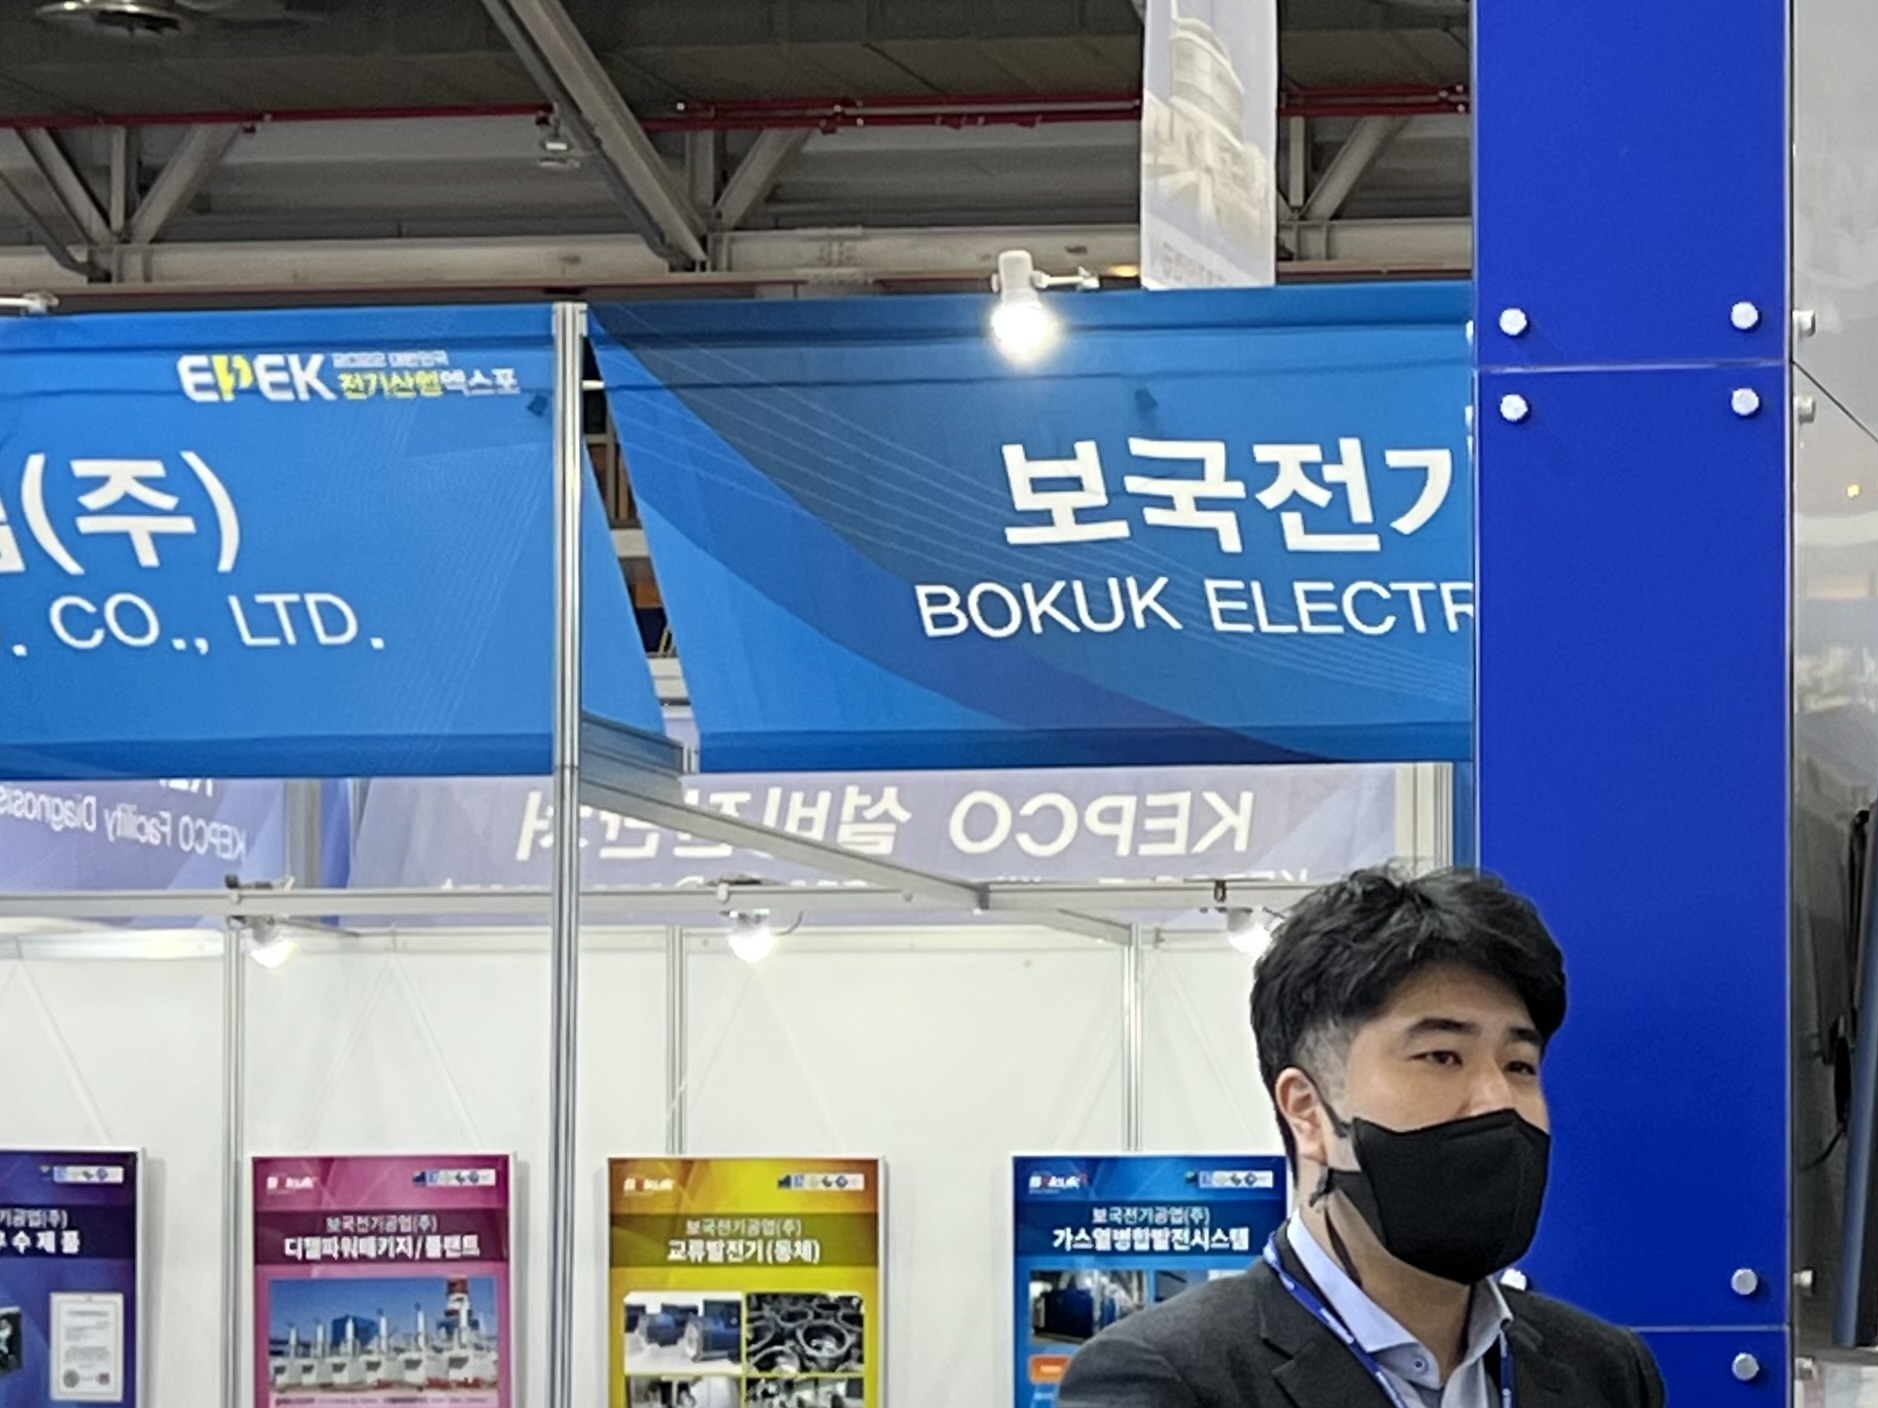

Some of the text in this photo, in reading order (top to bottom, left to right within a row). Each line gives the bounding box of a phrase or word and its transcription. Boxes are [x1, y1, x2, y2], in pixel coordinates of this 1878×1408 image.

[177, 353, 338, 403] EPEK
[0, 450, 241, 575] (주)
[48, 592, 386, 655] CO., LTD.
[914, 576, 1183, 640] BOKUK
